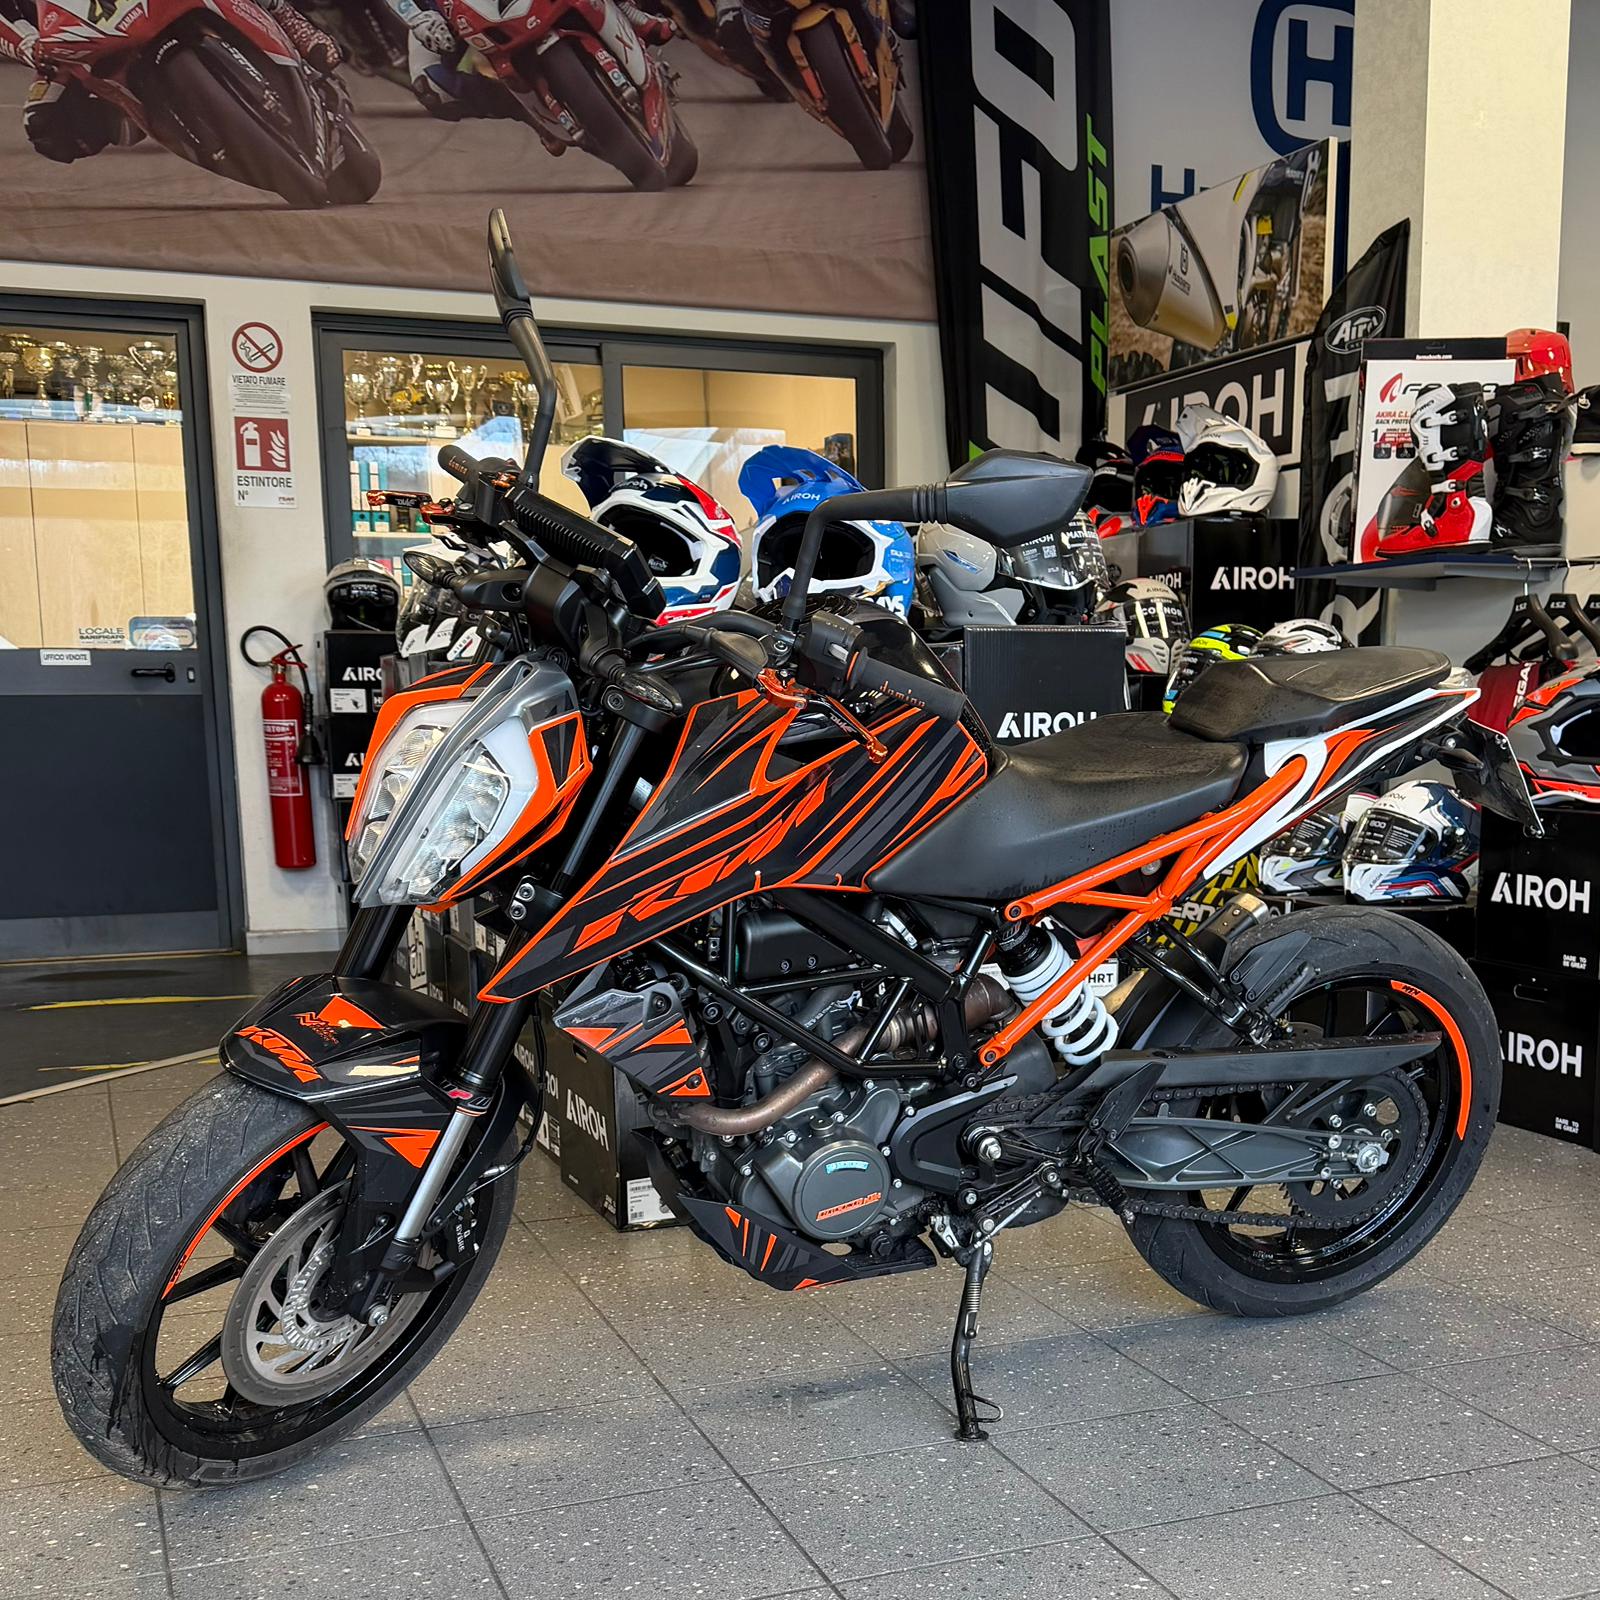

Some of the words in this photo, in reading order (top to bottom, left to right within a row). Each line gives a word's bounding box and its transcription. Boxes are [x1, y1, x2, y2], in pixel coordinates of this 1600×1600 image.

[117, 6, 144, 31] YAMAHA
[970, 0, 1083, 458] UFO
[1086, 113, 1108, 398] PLAST
[232, 375, 258, 385] VIETATO
[259, 376, 286, 386] FUMARE
[237, 475, 293, 488] ESTINTORE
[1210, 566, 1295, 590] AIROH
[1550, 601, 1566, 609] LS2
[79, 627, 124, 635] LOCALE
[43, 653, 64, 661] UFFICIO
[66, 653, 88, 661] VENDITE
[880, 681, 926, 708] domino
[1490, 872, 1591, 914] AIROH
[234, 1025, 323, 1084] KTM
[1500, 1030, 1583, 1078] IROH
[566, 1089, 610, 1151] AIROH
